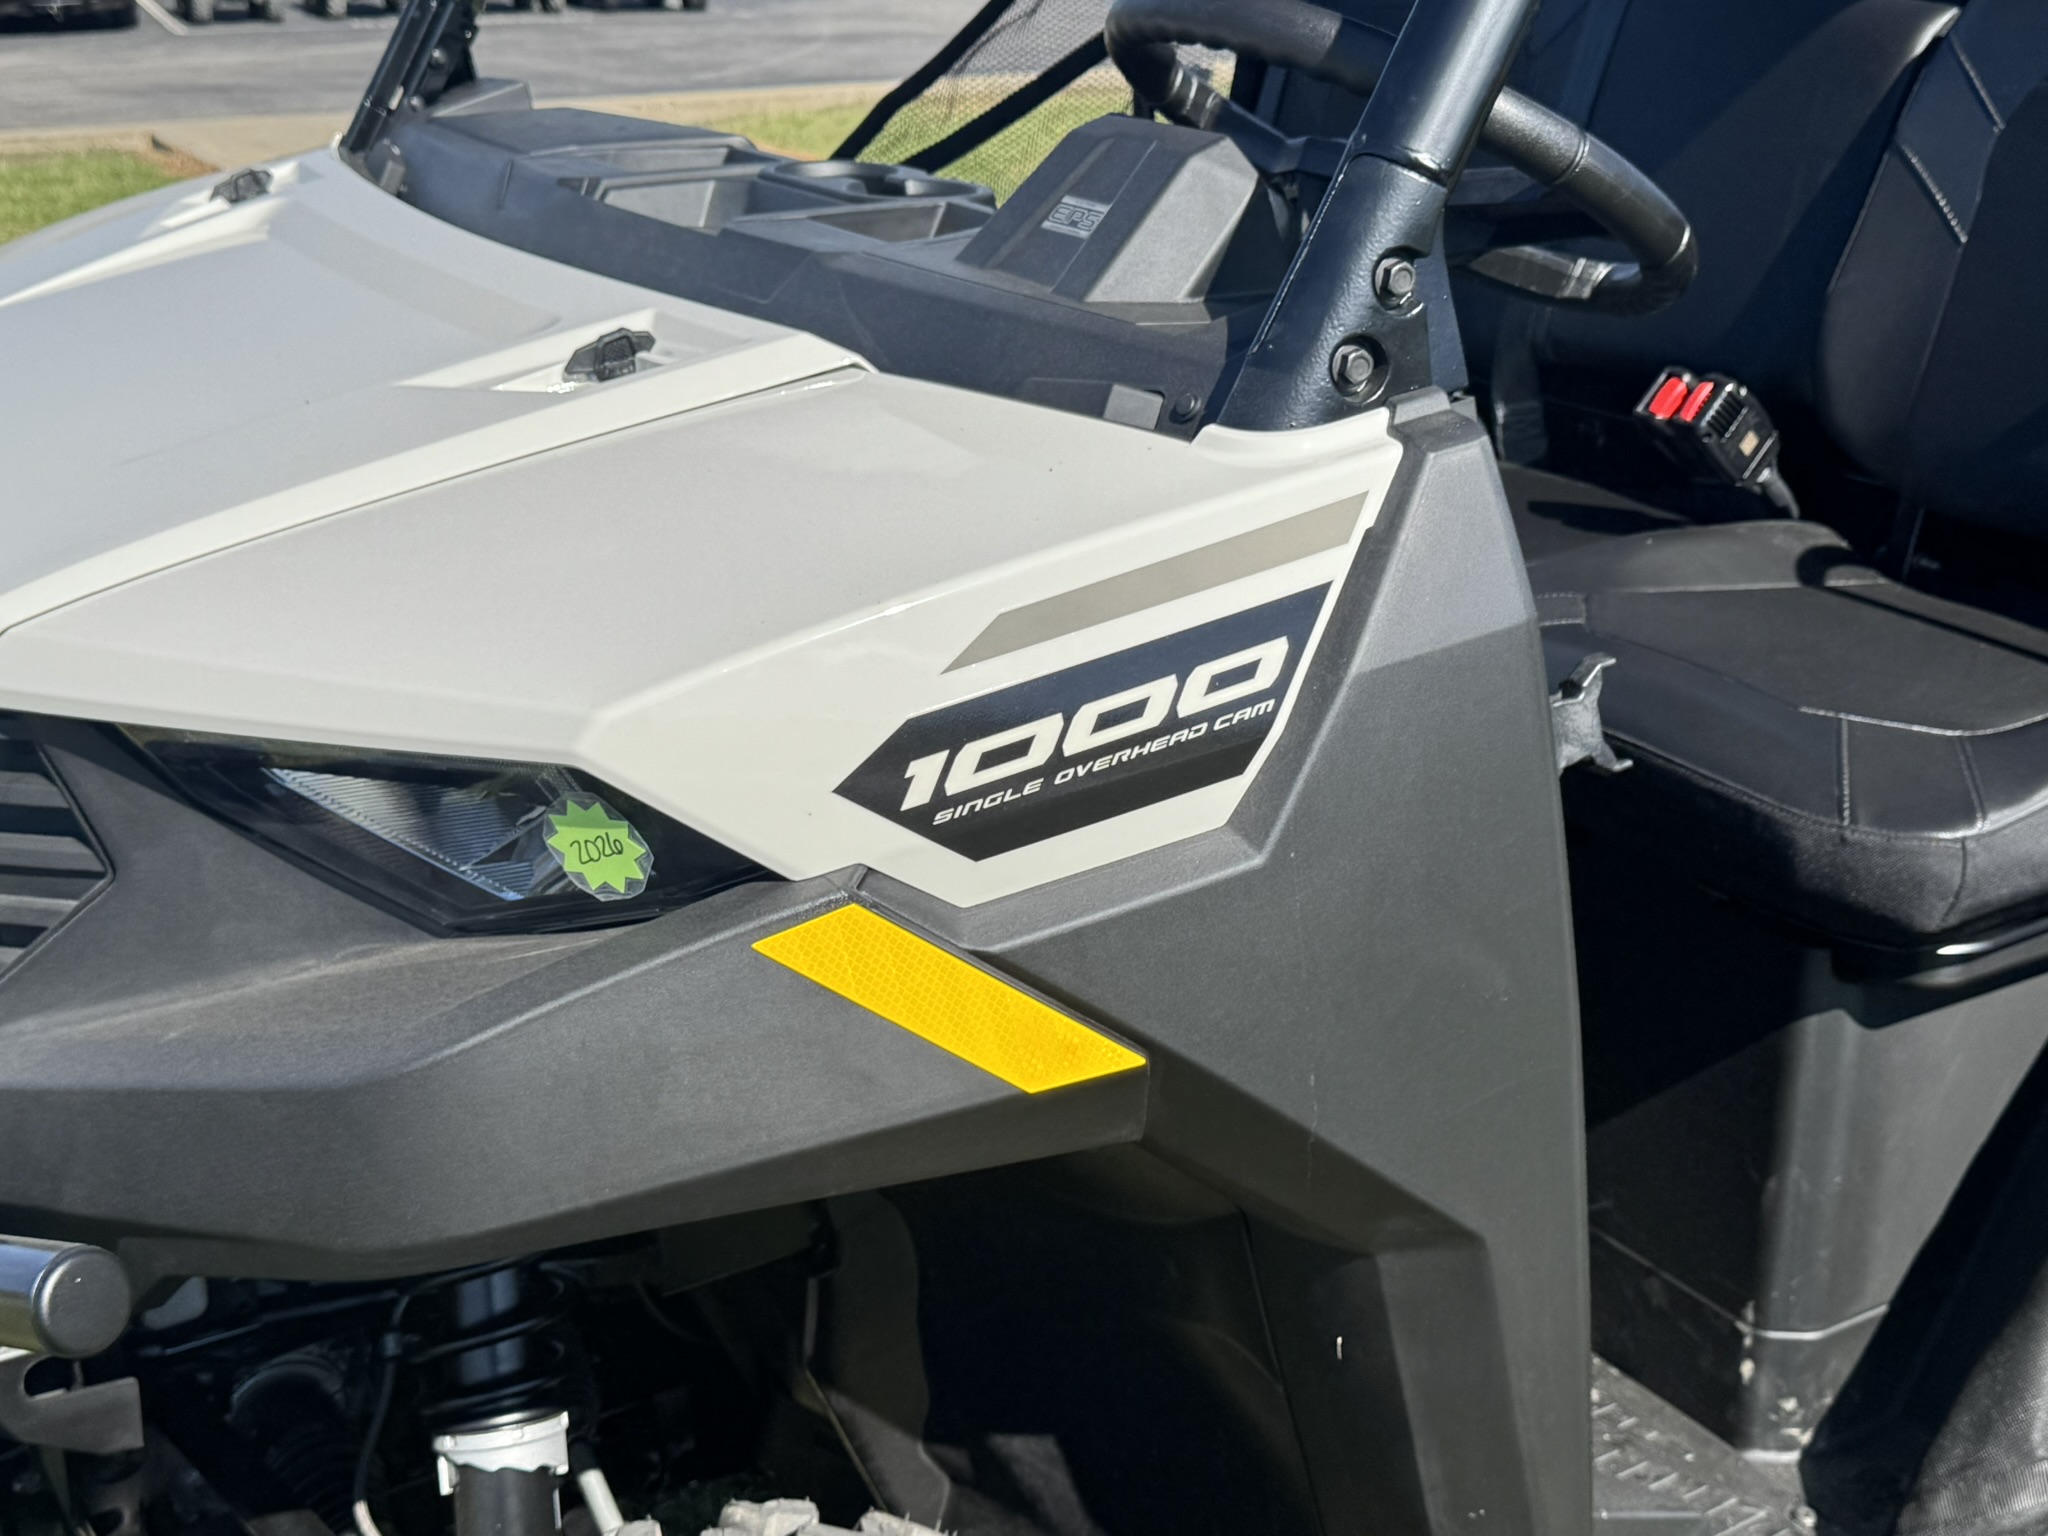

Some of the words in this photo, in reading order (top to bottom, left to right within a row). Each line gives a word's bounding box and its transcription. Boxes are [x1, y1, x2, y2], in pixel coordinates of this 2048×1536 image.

[1048, 203, 1106, 233] EPS
[900, 635, 1290, 812] 1000
[932, 778, 1044, 826] SINGLE
[1053, 721, 1209, 785] OVERHEAD
[1213, 698, 1276, 731] CAM
[569, 831, 624, 865] 2026
